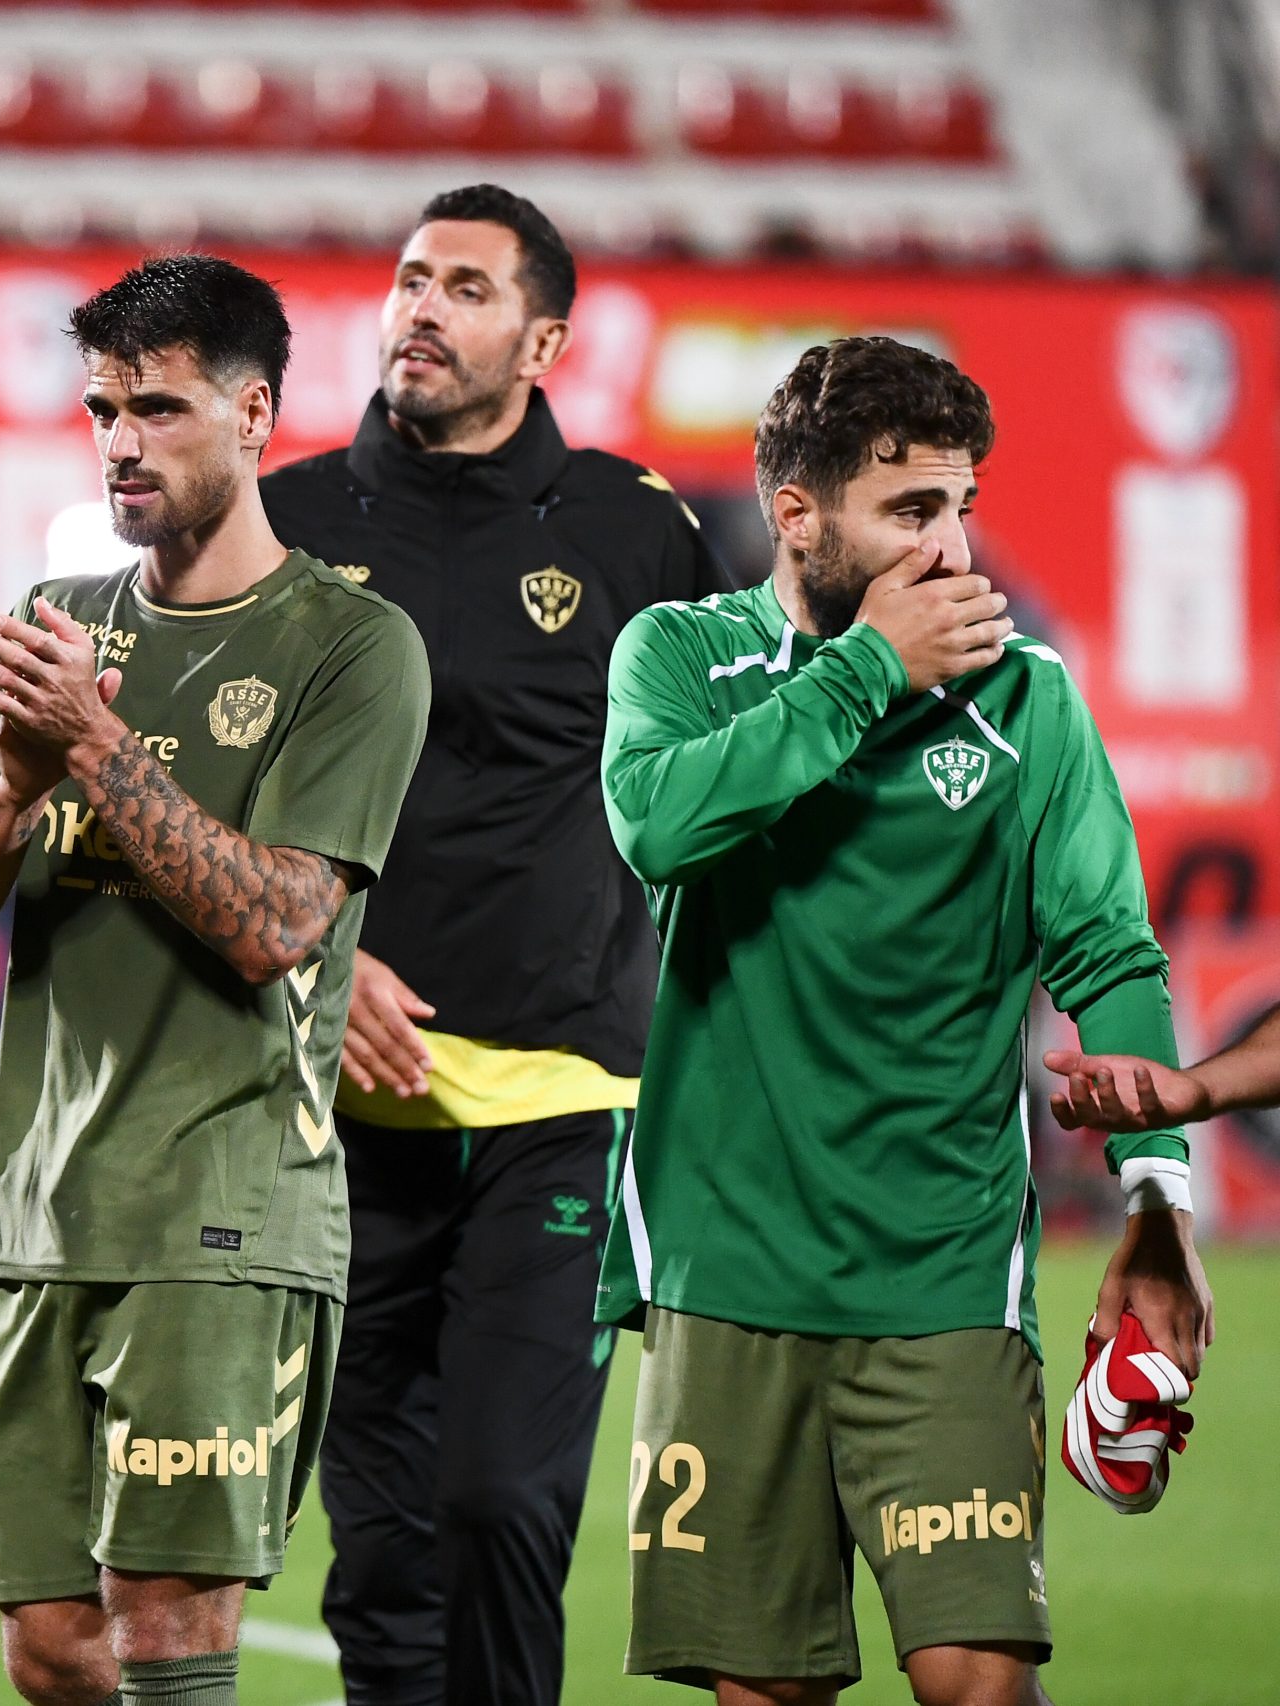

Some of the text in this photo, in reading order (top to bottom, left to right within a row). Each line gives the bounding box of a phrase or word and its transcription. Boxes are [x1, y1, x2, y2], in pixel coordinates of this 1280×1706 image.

[226, 688, 268, 706] ASSE
[932, 751, 981, 768] ASSE
[107, 1423, 268, 1486] Kapriol
[628, 1440, 707, 1553] 22
[880, 1487, 1033, 1557] Kapriol
